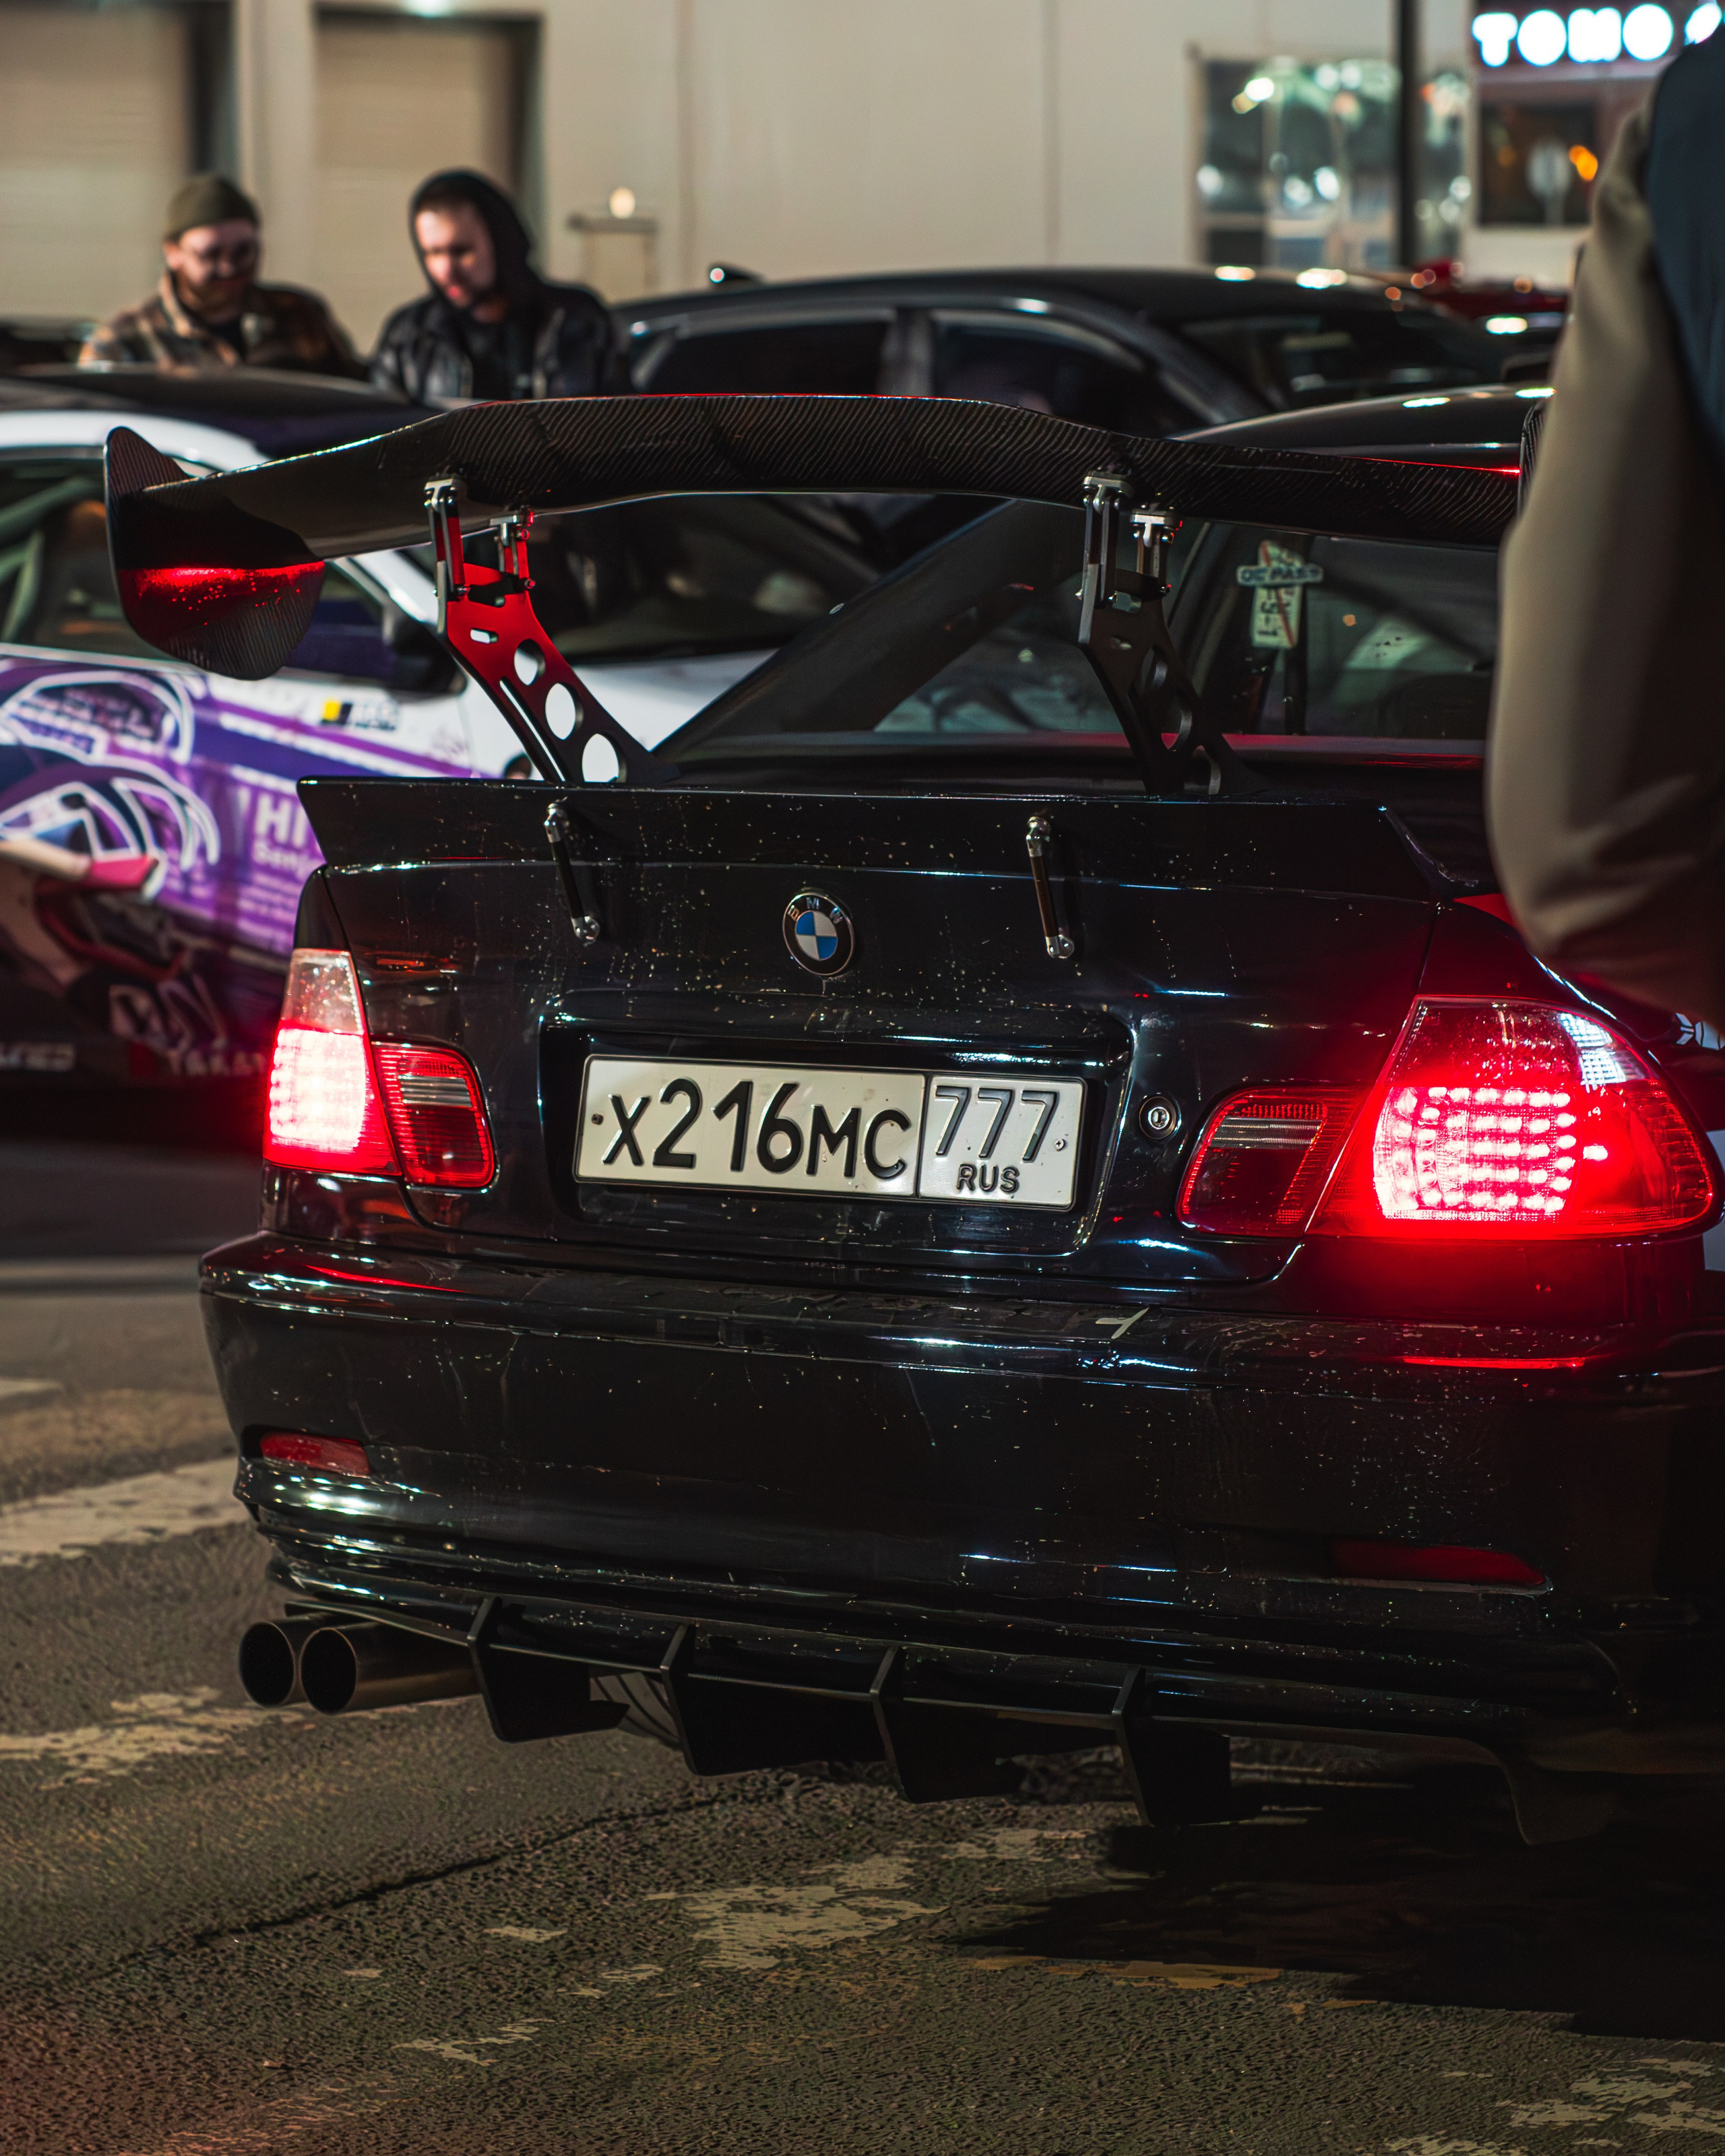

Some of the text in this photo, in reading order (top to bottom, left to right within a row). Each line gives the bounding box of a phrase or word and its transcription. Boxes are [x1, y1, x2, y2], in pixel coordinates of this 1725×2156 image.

[787, 897, 843, 924] BMW
[934, 1085, 1059, 1163] 777
[955, 1163, 1020, 1193] RUS
